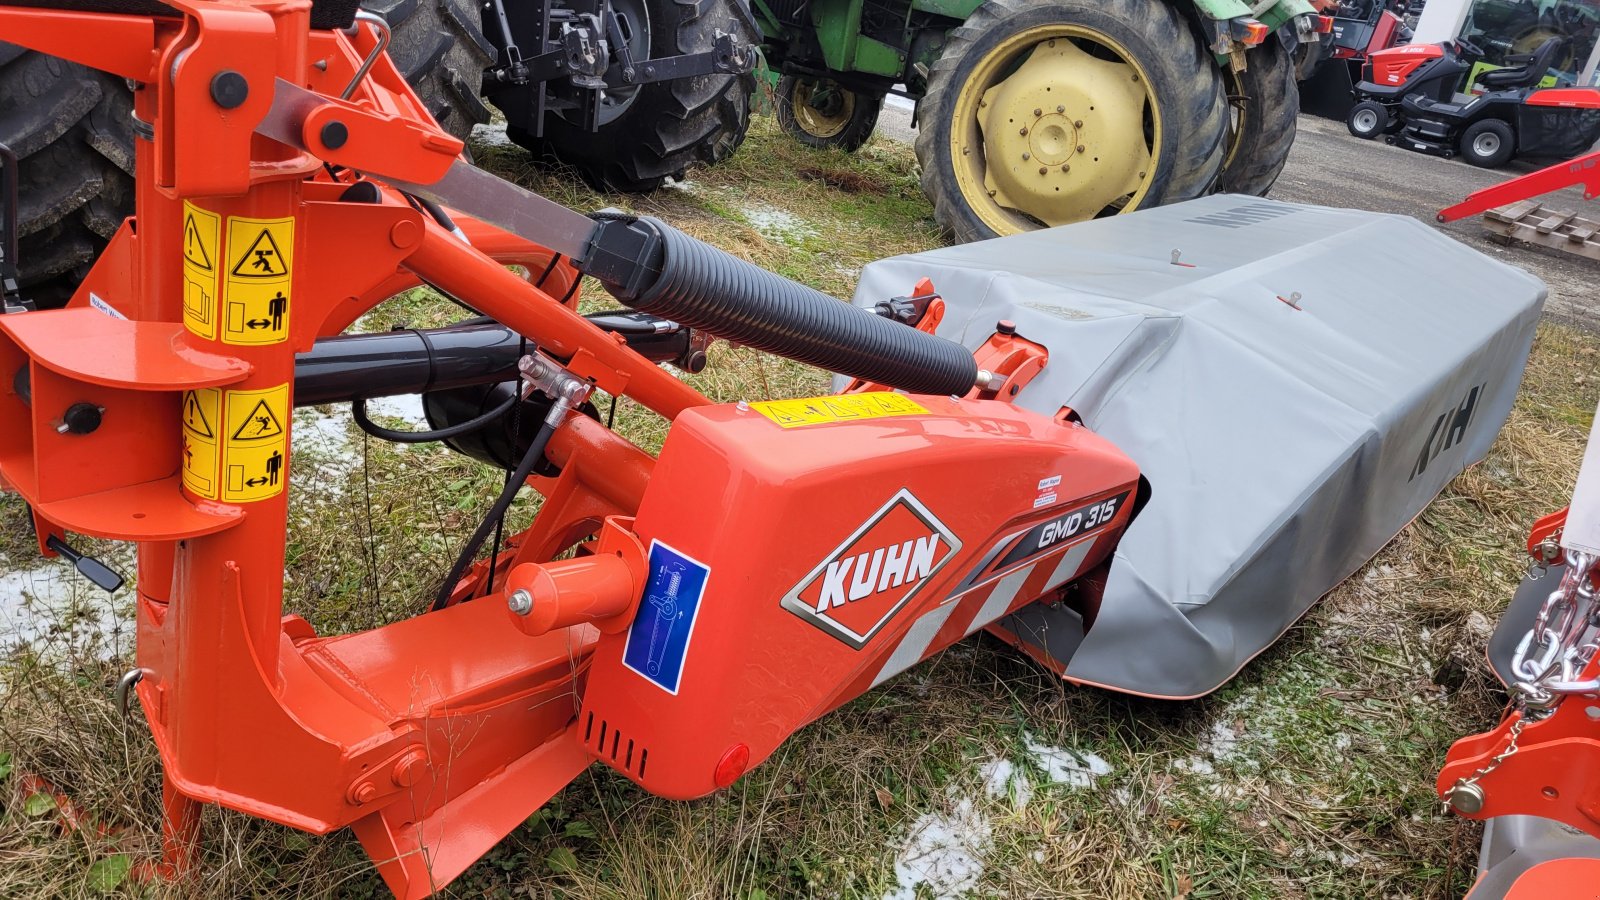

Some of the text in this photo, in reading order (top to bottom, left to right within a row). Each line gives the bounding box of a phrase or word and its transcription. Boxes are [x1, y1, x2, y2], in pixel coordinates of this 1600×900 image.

[1038, 498, 1117, 548] GMD 315
[815, 532, 940, 615] KUHN
